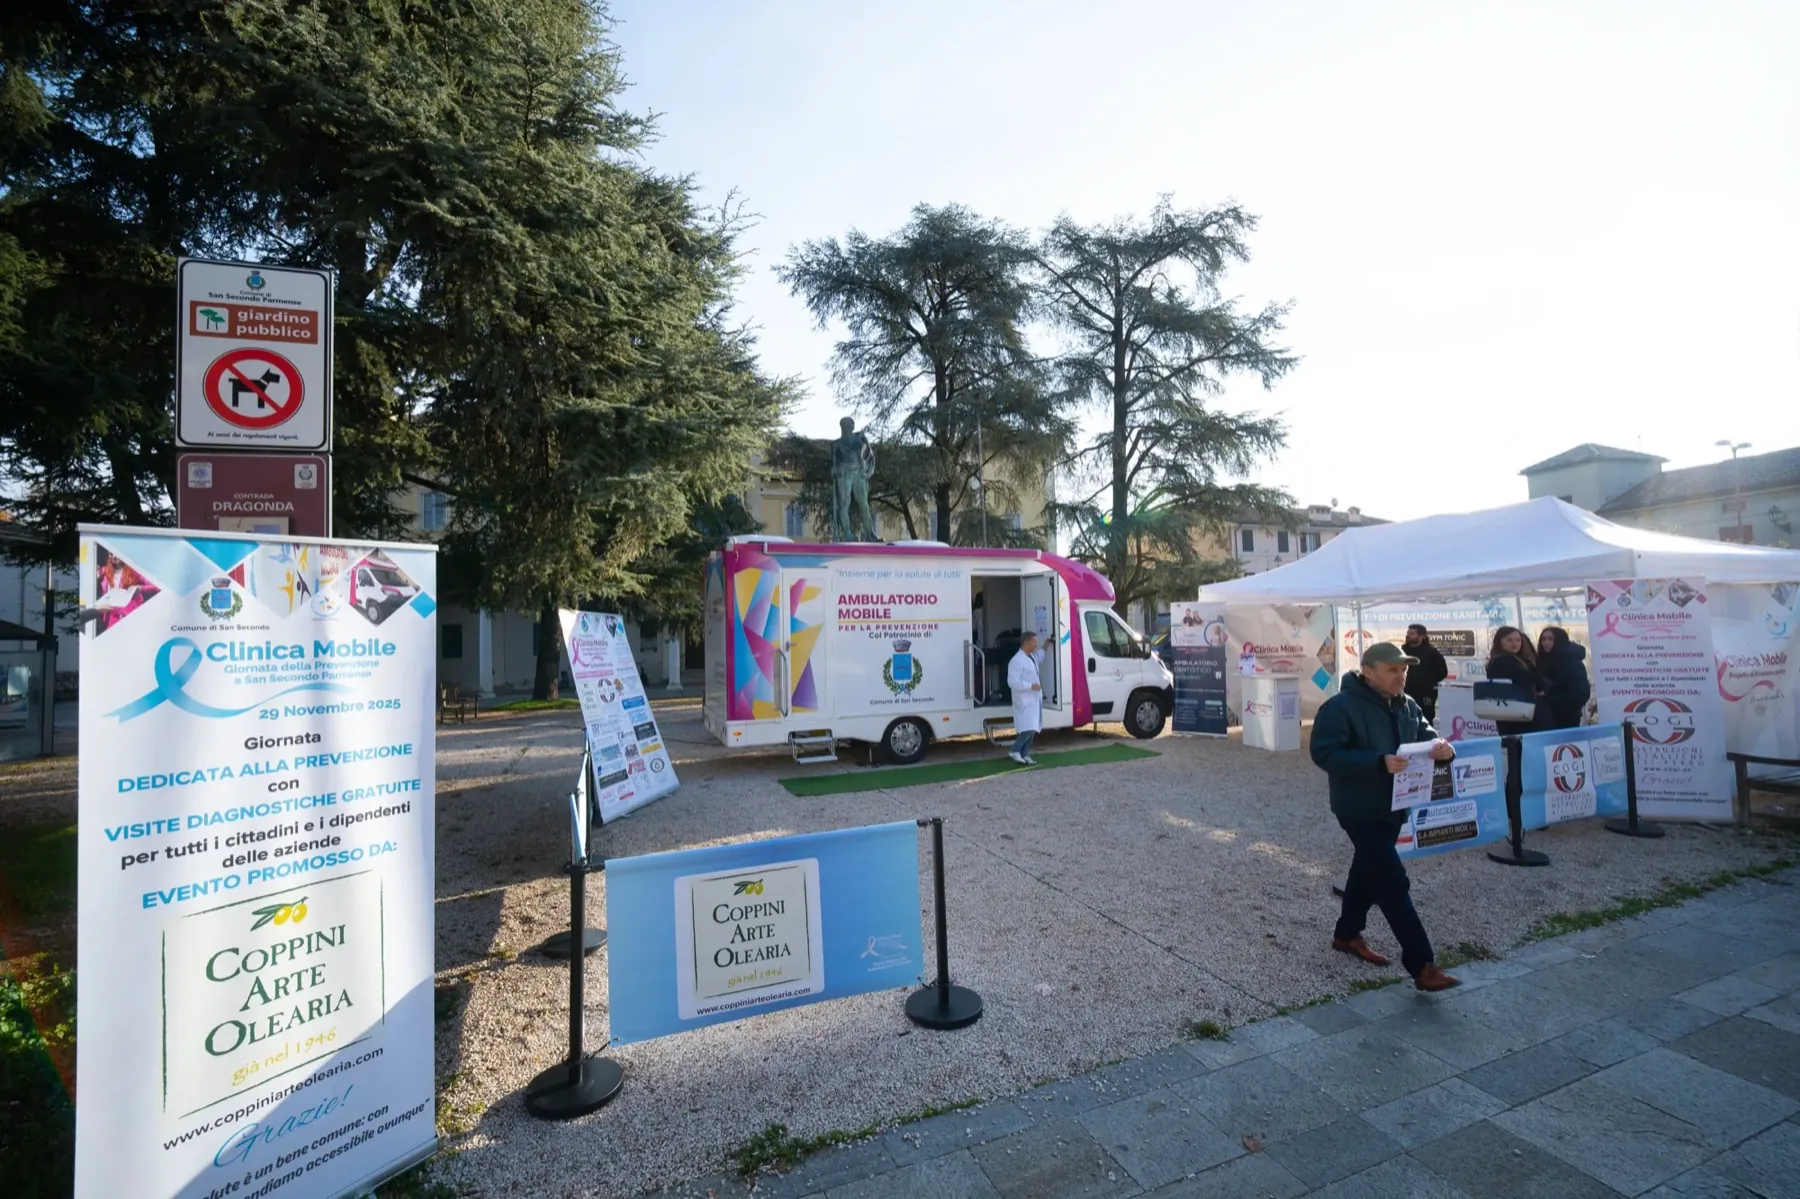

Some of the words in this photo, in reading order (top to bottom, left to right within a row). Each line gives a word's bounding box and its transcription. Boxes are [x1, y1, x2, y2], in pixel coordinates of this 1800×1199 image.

[226, 293, 260, 302] Secondo
[262, 297, 302, 306] Parmense
[237, 309, 310, 325] giardino
[236, 323, 311, 339] pubblico
[234, 492, 274, 500] CONTRADA
[212, 501, 295, 512] DRAGONDA
[876, 570, 892, 580] per
[894, 570, 903, 578] la
[904, 570, 932, 578] salute
[933, 570, 942, 578] di
[838, 594, 938, 606] AMBULATORIO
[838, 608, 892, 620] MOBILE
[1390, 612, 1450, 621] PREVENZIONE
[1622, 613, 1655, 621] Clinica
[1657, 612, 1692, 620] Mobile
[170, 624, 207, 632] Comune
[209, 624, 218, 632] di
[838, 624, 856, 632] PER
[884, 630, 922, 639] Patrocinio
[206, 639, 306, 662] Clinica
[314, 638, 397, 658] Mobile
[224, 662, 278, 674] Giornata
[280, 660, 312, 672] della
[314, 658, 380, 670] Prevenzione
[1726, 655, 1761, 668] Clinica
[1760, 652, 1788, 666] Mobile
[244, 674, 266, 684] San
[269, 672, 320, 682] Secondo
[322, 670, 372, 681] Parmense
[259, 708, 279, 720] 29
[284, 701, 364, 718] Novembre
[368, 698, 401, 710] 2025
[1466, 720, 1498, 732] Clinic
[244, 732, 322, 751] Giornata
[1634, 746, 1703, 754] OSTRUZIONI
[118, 766, 234, 793] DEDICATA
[239, 759, 290, 778] ALLA
[294, 744, 413, 770] PREVENZIONE
[1432, 766, 1448, 776] ONIC
[1454, 764, 1472, 780] TZ
[1553, 760, 1585, 775] COGI
[268, 778, 300, 792] con
[104, 816, 181, 842] VISITE
[186, 792, 337, 830] DIAGNOSTICHE
[342, 778, 422, 802] GRATUITE
[120, 850, 159, 870] per
[165, 838, 208, 860] tutti
[214, 836, 220, 850] i
[225, 820, 299, 848] cittadini
[304, 821, 314, 832] e
[319, 816, 324, 830] i
[329, 801, 412, 830] dipendenti
[222, 848, 268, 869] delle
[274, 834, 342, 858] aziende
[142, 874, 242, 910] EVENTO
[247, 847, 364, 886] PROMOSSO
[368, 839, 398, 858] DA:
[712, 900, 786, 924] COPPINI
[730, 923, 776, 944] ARTE
[205, 924, 347, 982] COPPINI
[713, 942, 792, 968] OLEARIA
[727, 973, 742, 988] già
[744, 969, 758, 982] nel
[760, 967, 784, 981] 1946
[238, 963, 327, 1012] ARTE
[696, 986, 811, 1016] www.coppiniarteolearia.com
[204, 988, 354, 1057] OLEARIA
[230, 1058, 260, 1087] già
[264, 1043, 290, 1068] nel
[295, 1026, 338, 1055] 1946
[163, 1048, 384, 1151] www.coppiniarteolearia.com
[213, 1083, 355, 1168] Grazie!
[306, 1128, 375, 1172] accessibile
[377, 1097, 431, 1137] ovunque"
[244, 1172, 252, 1186] è
[255, 1162, 273, 1180] un
[276, 1144, 309, 1169] bene
[311, 1116, 365, 1150] comune:
[368, 1104, 389, 1122] con
